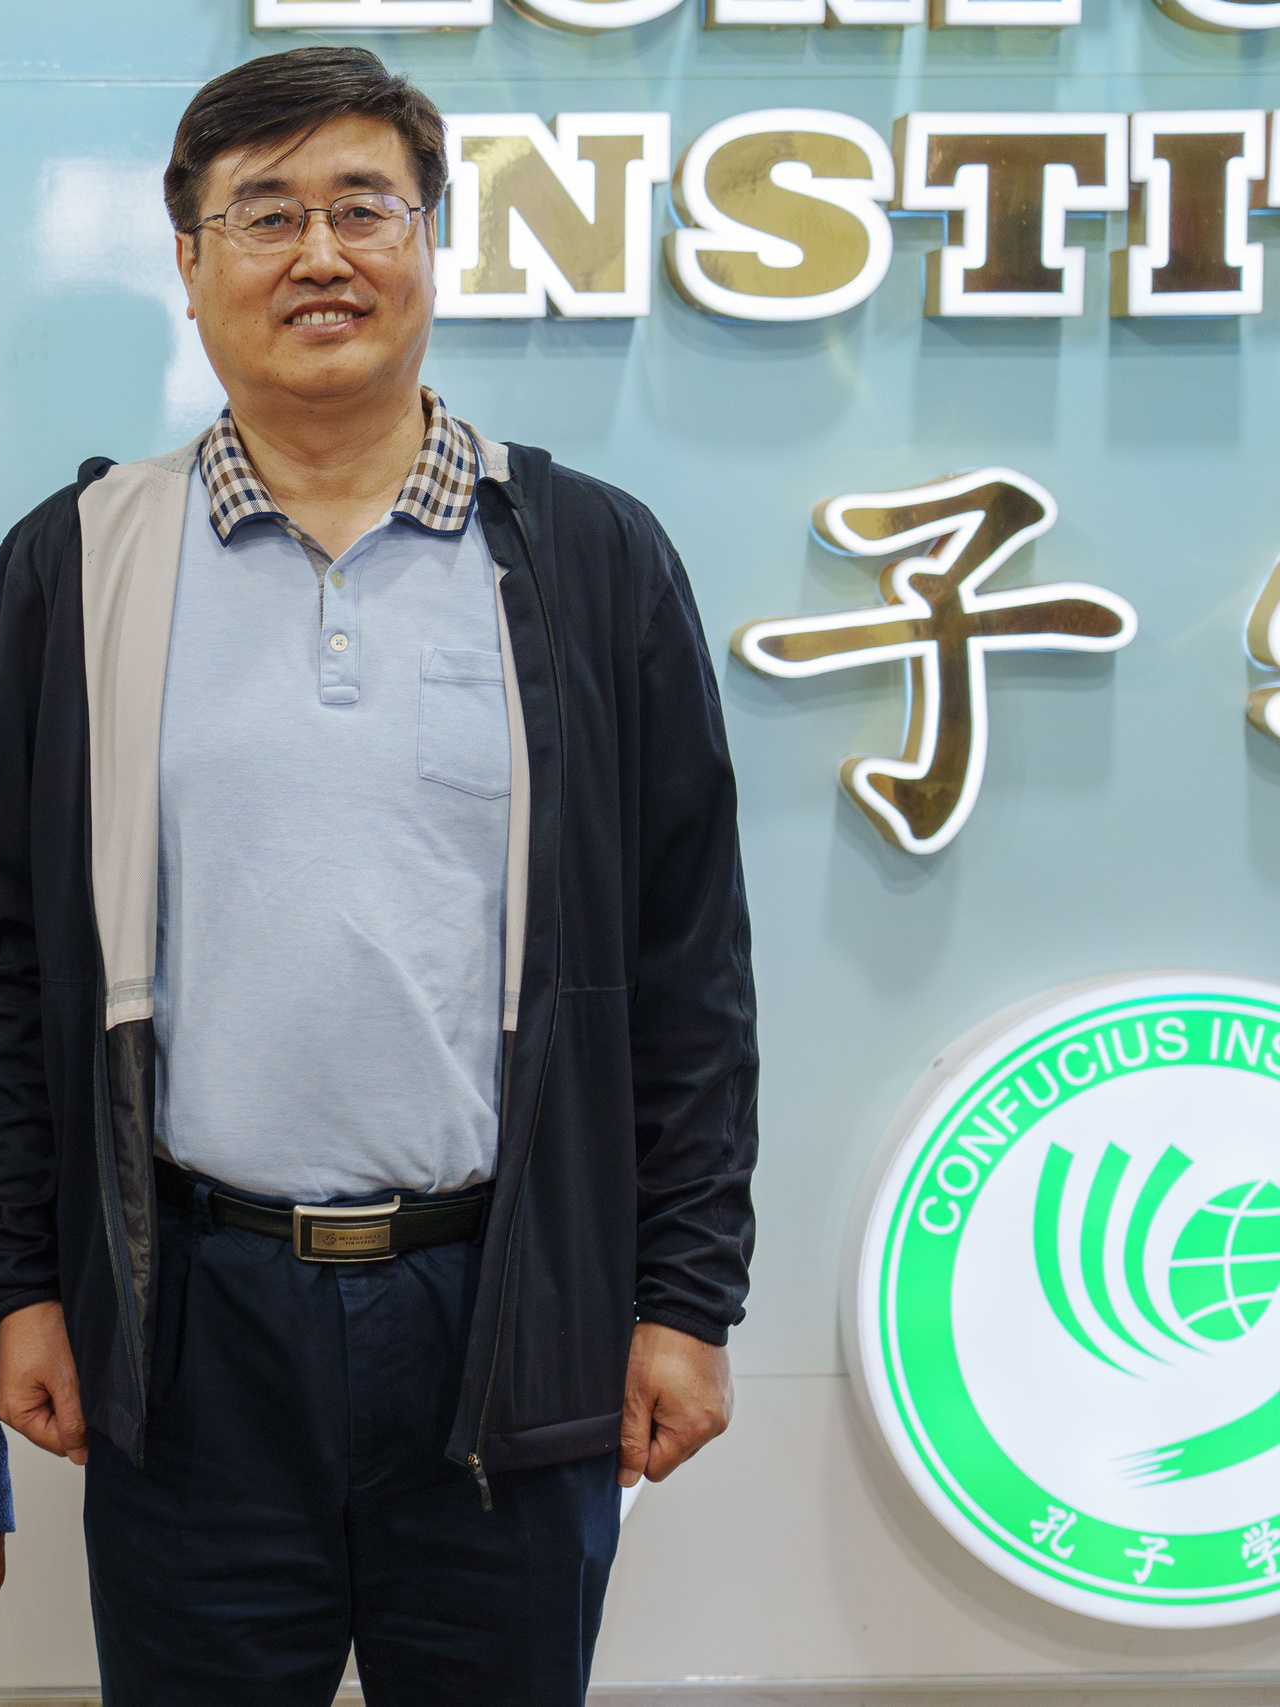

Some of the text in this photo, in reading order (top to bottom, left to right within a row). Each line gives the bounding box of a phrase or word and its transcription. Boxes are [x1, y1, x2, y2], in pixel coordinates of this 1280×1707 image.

[434, 110, 1280, 321] NSTI
[732, 467, 1280, 855] 子
[918, 1016, 1190, 1236] CONFUCIUS
